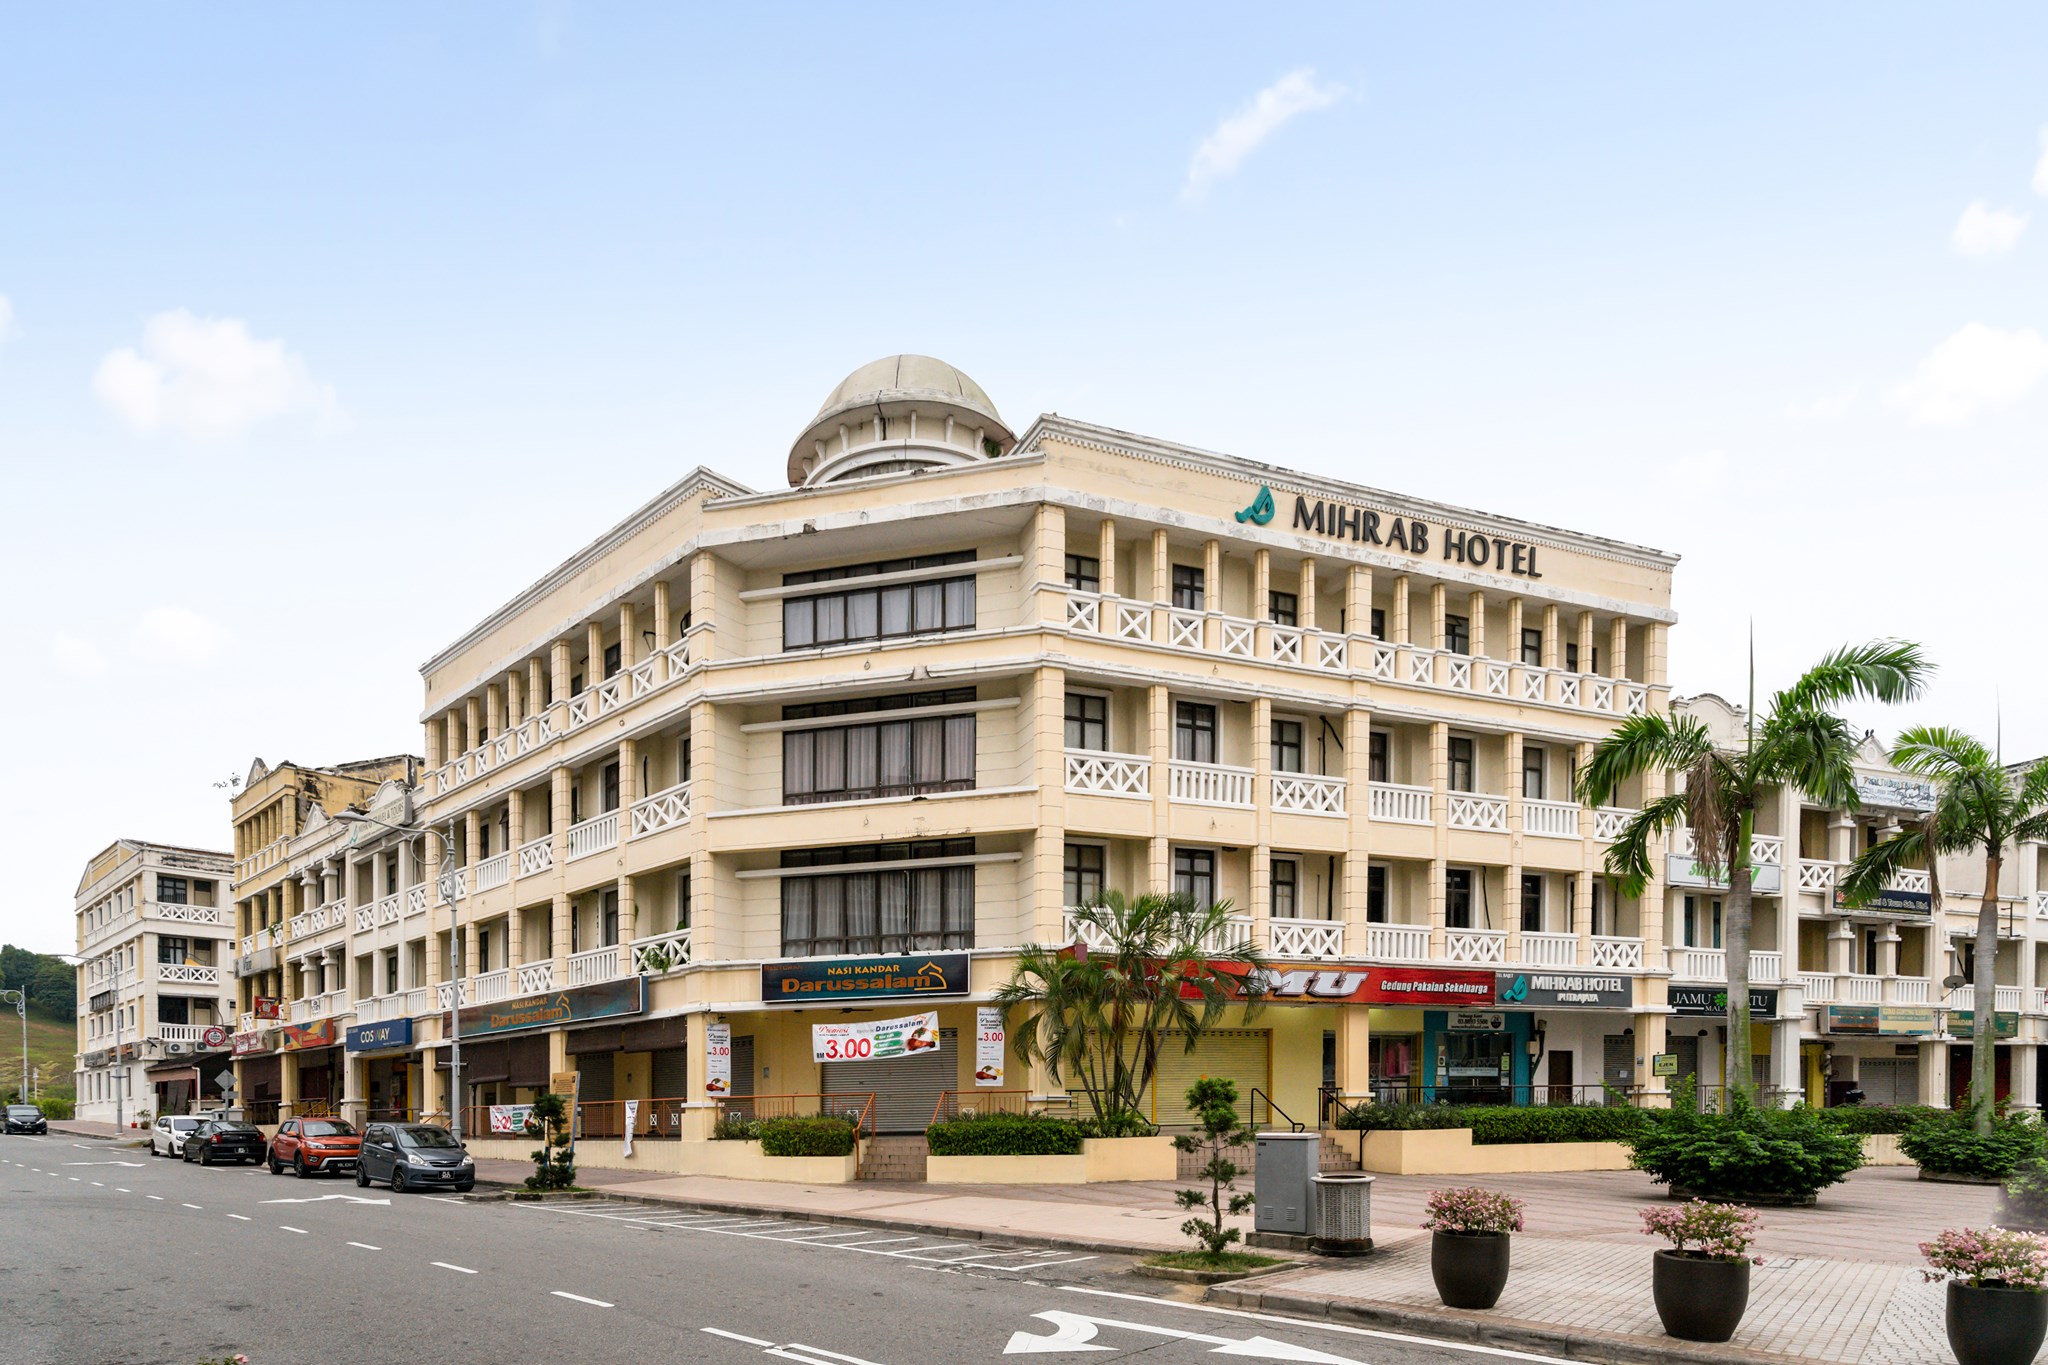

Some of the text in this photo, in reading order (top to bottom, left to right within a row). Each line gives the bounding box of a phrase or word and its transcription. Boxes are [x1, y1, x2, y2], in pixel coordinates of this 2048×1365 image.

[1293, 496, 1543, 578] MIHRAB HOTEL
[827, 964, 900, 976] NASI KANDAR
[782, 974, 931, 993] Darussalam
[1381, 980, 1488, 995] Gedung Pakaian Sekeluarga
[1531, 975, 1625, 992] MIHRAB HOTEL
[511, 997, 548, 1010] NASI KANDAR
[1557, 993, 1599, 1004] PUTRAJAYA
[1673, 993, 1711, 1005] JAMU
[491, 1006, 563, 1028] Darussalam
[818, 1026, 850, 1034] Promosi
[875, 1019, 924, 1032] Darussalam
[360, 1027, 390, 1044] COSWAY
[984, 1032, 1003, 1041] 3.00
[712, 1047, 729, 1056] 3.00
[826, 1038, 871, 1059] 3.00
